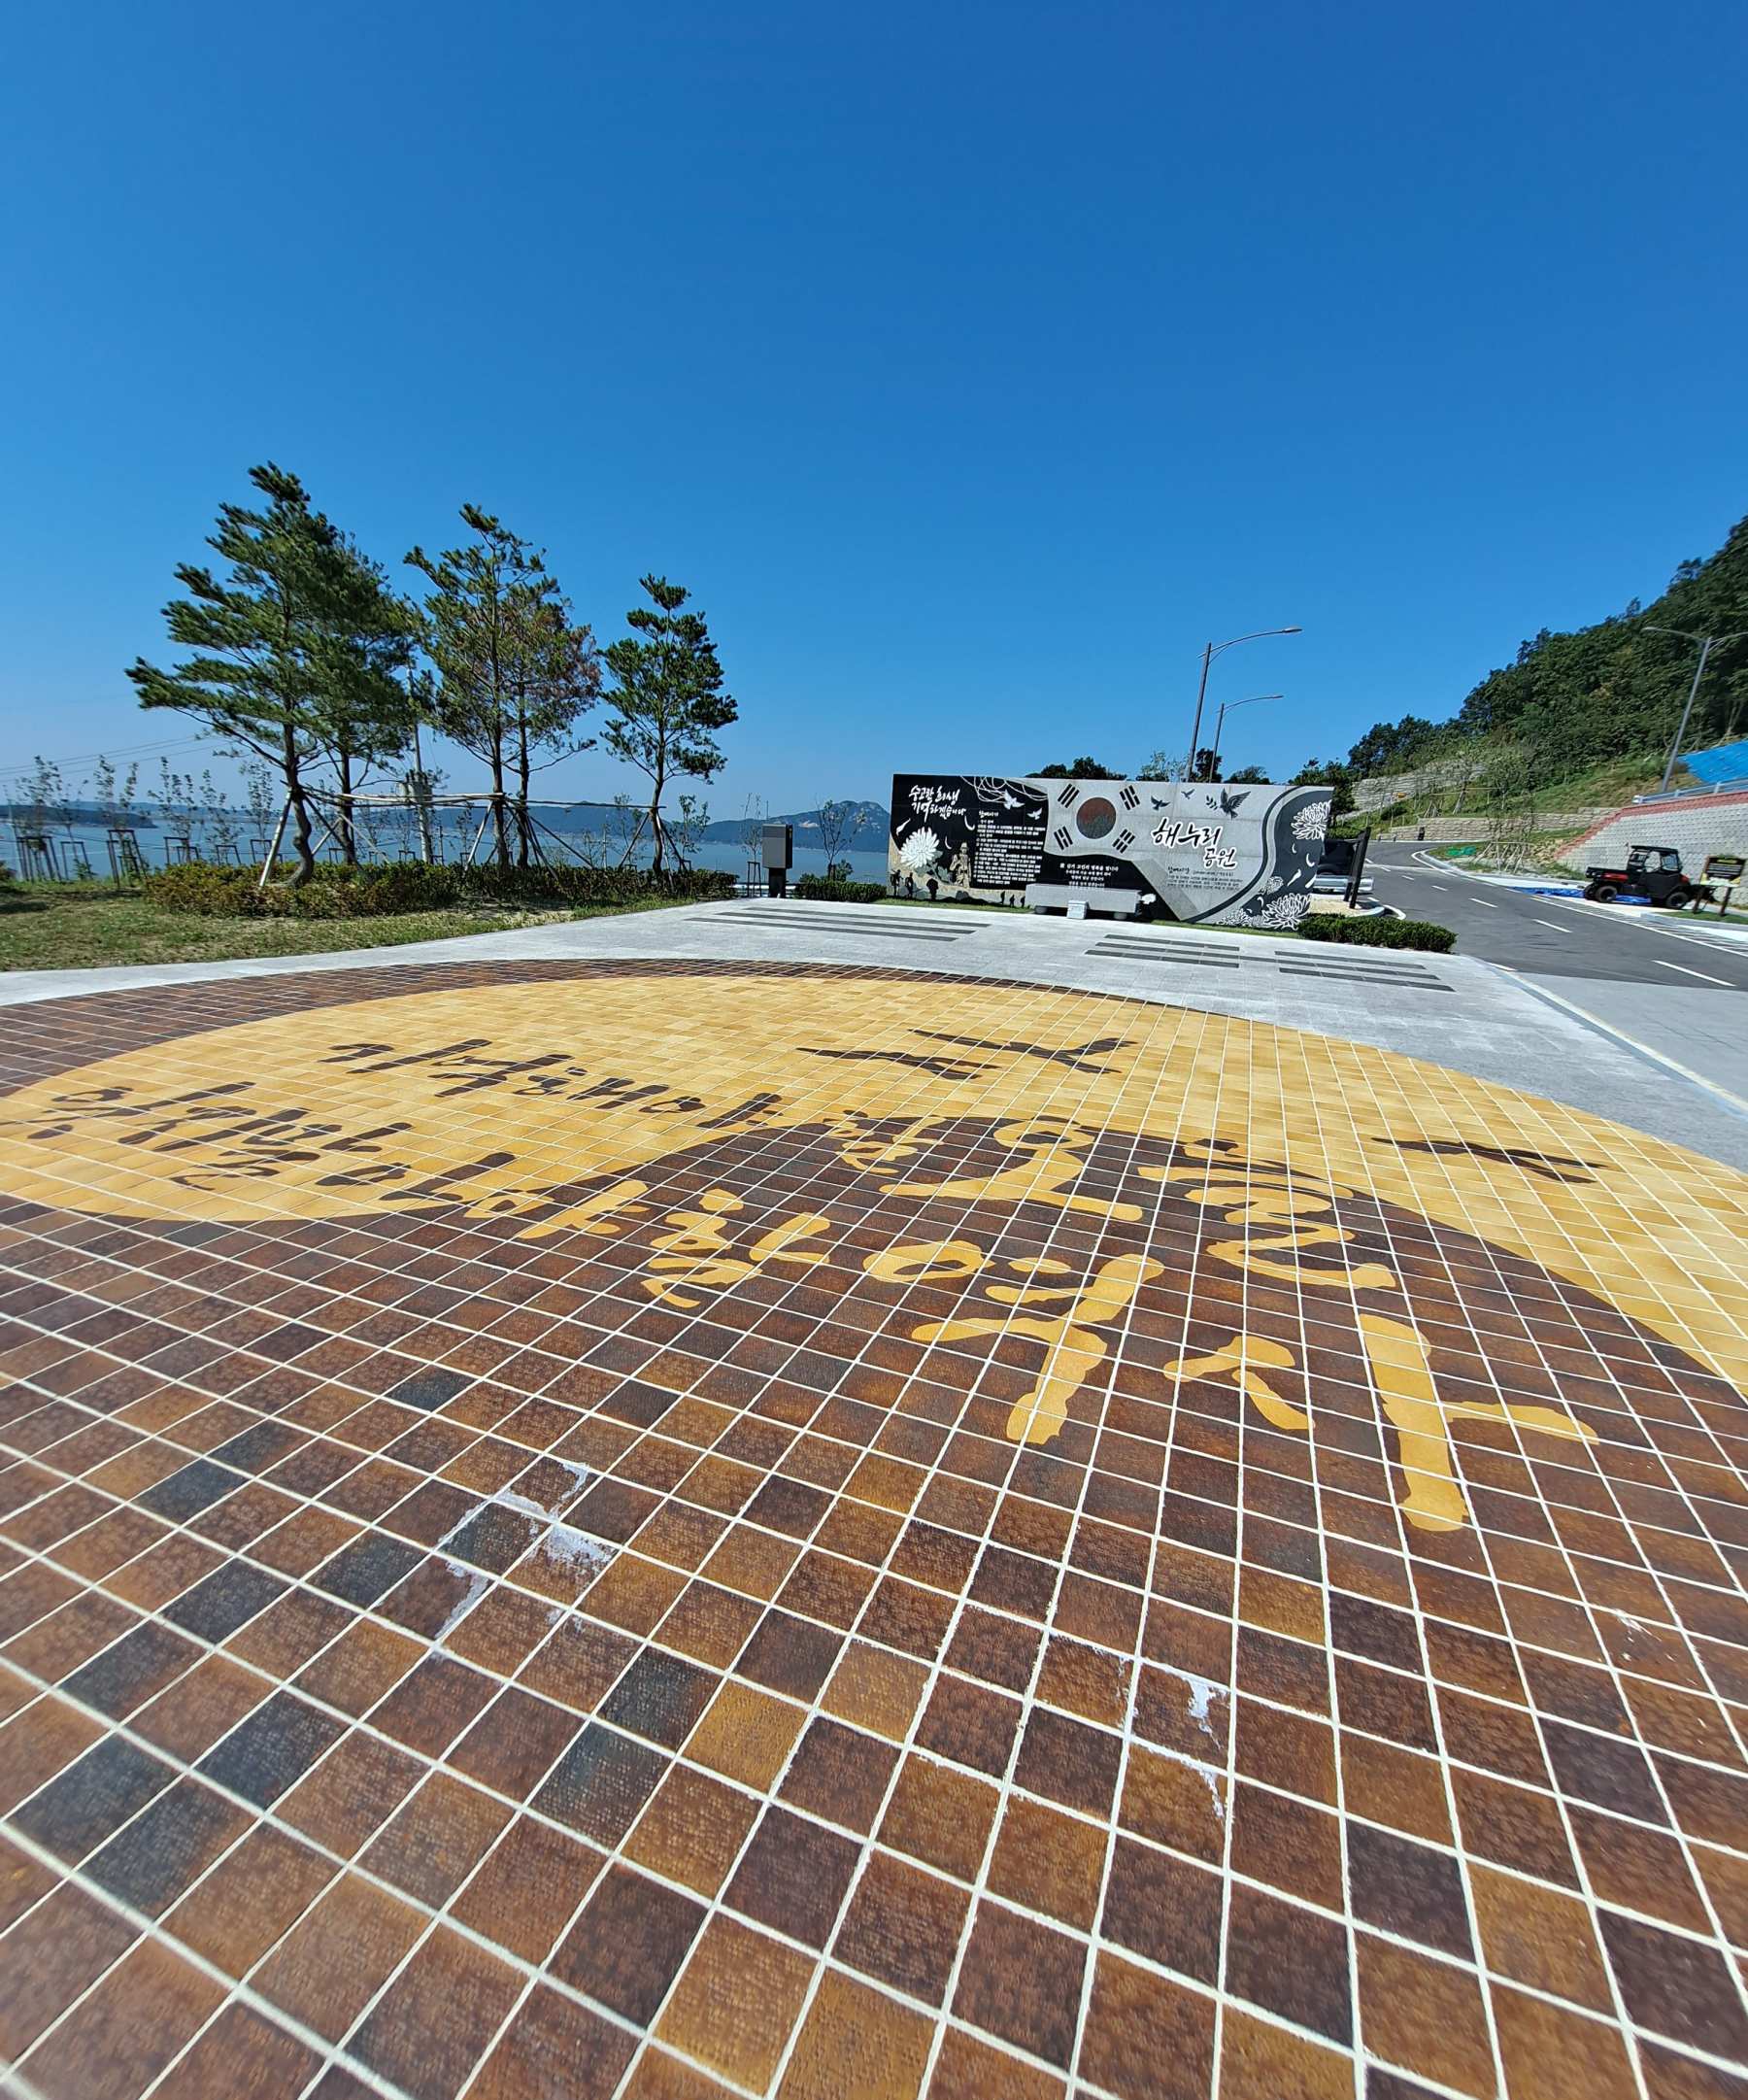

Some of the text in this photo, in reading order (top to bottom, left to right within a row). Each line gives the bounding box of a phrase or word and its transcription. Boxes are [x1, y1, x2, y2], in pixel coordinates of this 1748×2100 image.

[935, 785, 960, 805] 희생
[912, 799, 966, 822] 기억하겠습니다
[1151, 817, 1223, 848] 해누리
[1204, 847, 1237, 869] 공원
